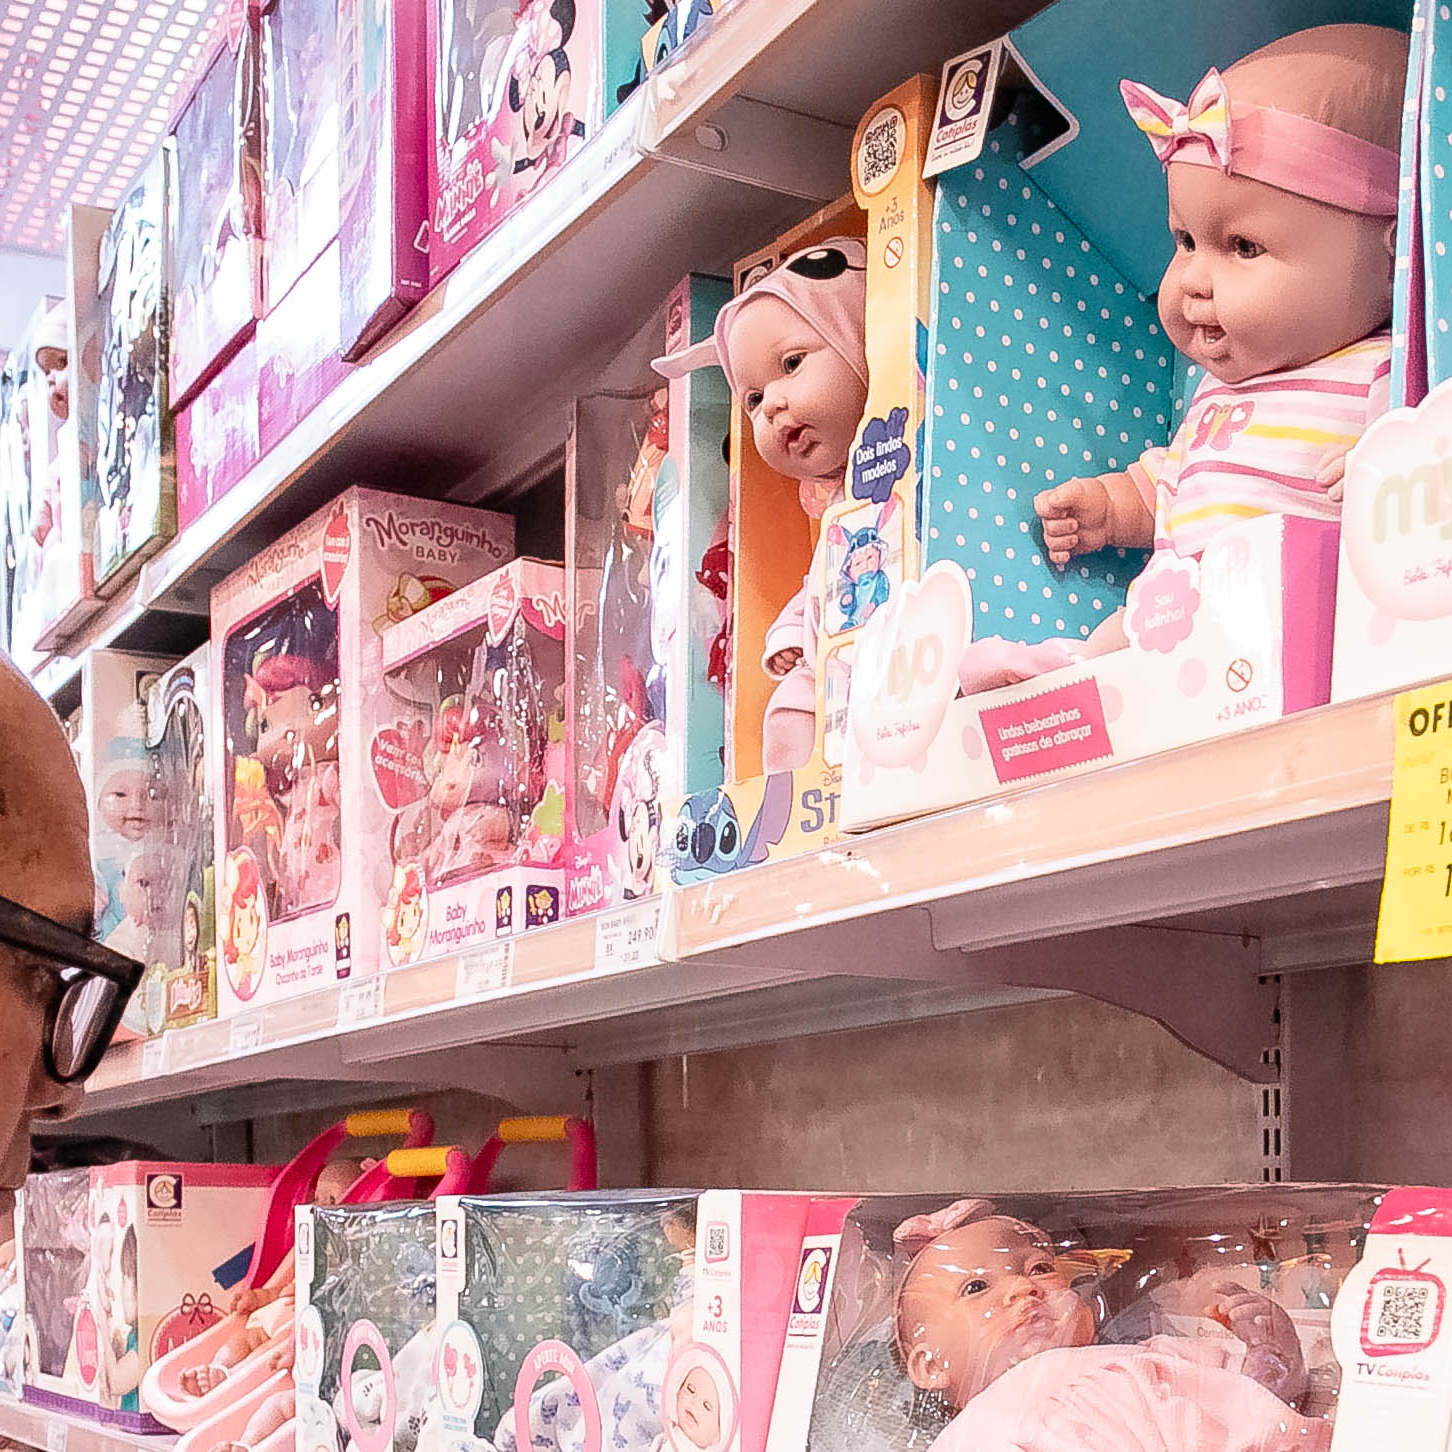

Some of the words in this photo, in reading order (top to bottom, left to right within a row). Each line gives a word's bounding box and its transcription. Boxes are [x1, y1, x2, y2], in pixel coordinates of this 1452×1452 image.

[936, 119, 978, 144] Cotiplás
[878, 210, 905, 234] Anos
[856, 446, 875, 465] Dois
[876, 436, 902, 457] lindos
[861, 459, 897, 484] modelos
[366, 512, 503, 559] Moranguinho
[415, 547, 460, 564] BABY
[998, 721, 1025, 741] Lindos
[1024, 707, 1081, 736] bebezinhos
[377, 738, 403, 758] Vem
[1002, 738, 1040, 764] gostosos
[1039, 733, 1054, 750] de
[1053, 722, 1093, 748] abraçar
[446, 903, 468, 922] Baby
[429, 920, 486, 946] Moranguinho
[706, 1295, 723, 1319] +3
[702, 1321, 728, 1334] ANOS
[1356, 1362, 1376, 1375] TV
